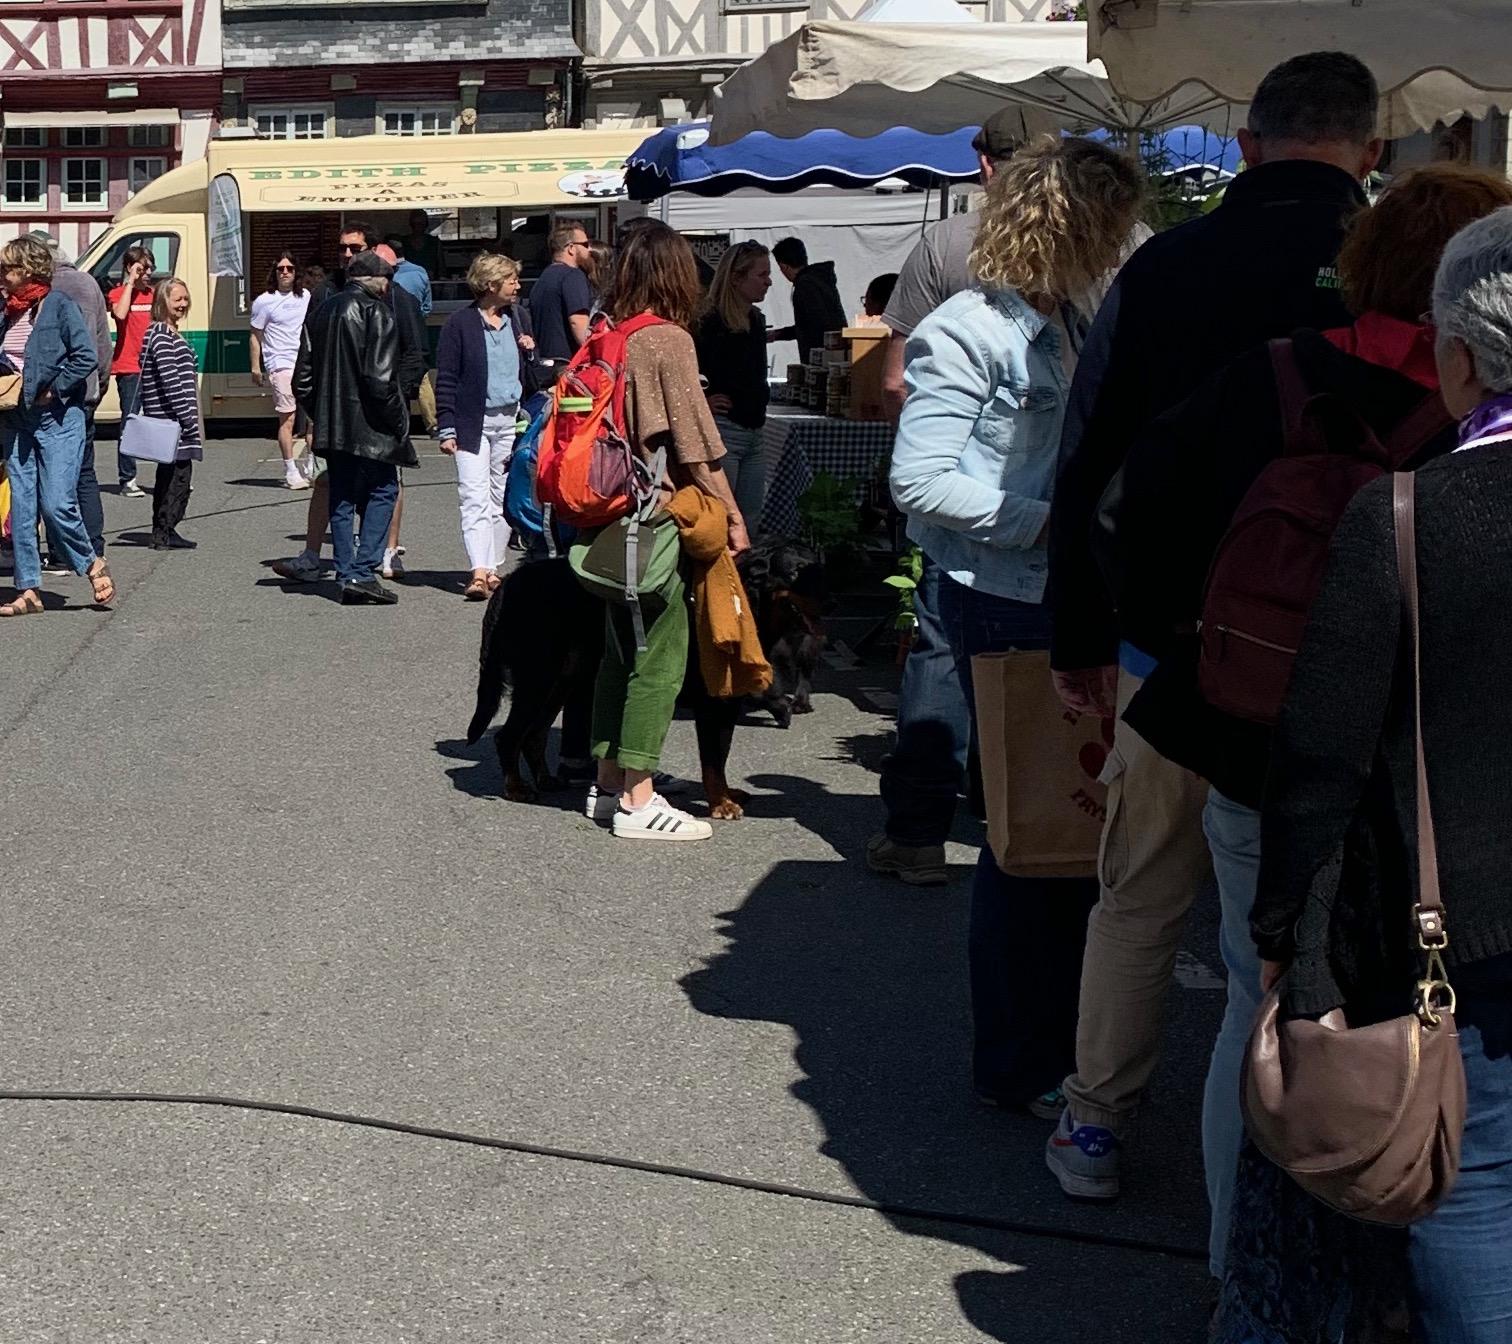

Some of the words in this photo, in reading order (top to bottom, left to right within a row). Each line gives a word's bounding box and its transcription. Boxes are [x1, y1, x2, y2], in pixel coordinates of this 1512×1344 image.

[248, 167, 427, 180] EDITH
[329, 181, 449, 190] PIZZAS
[294, 191, 486, 204] EMPORTER
